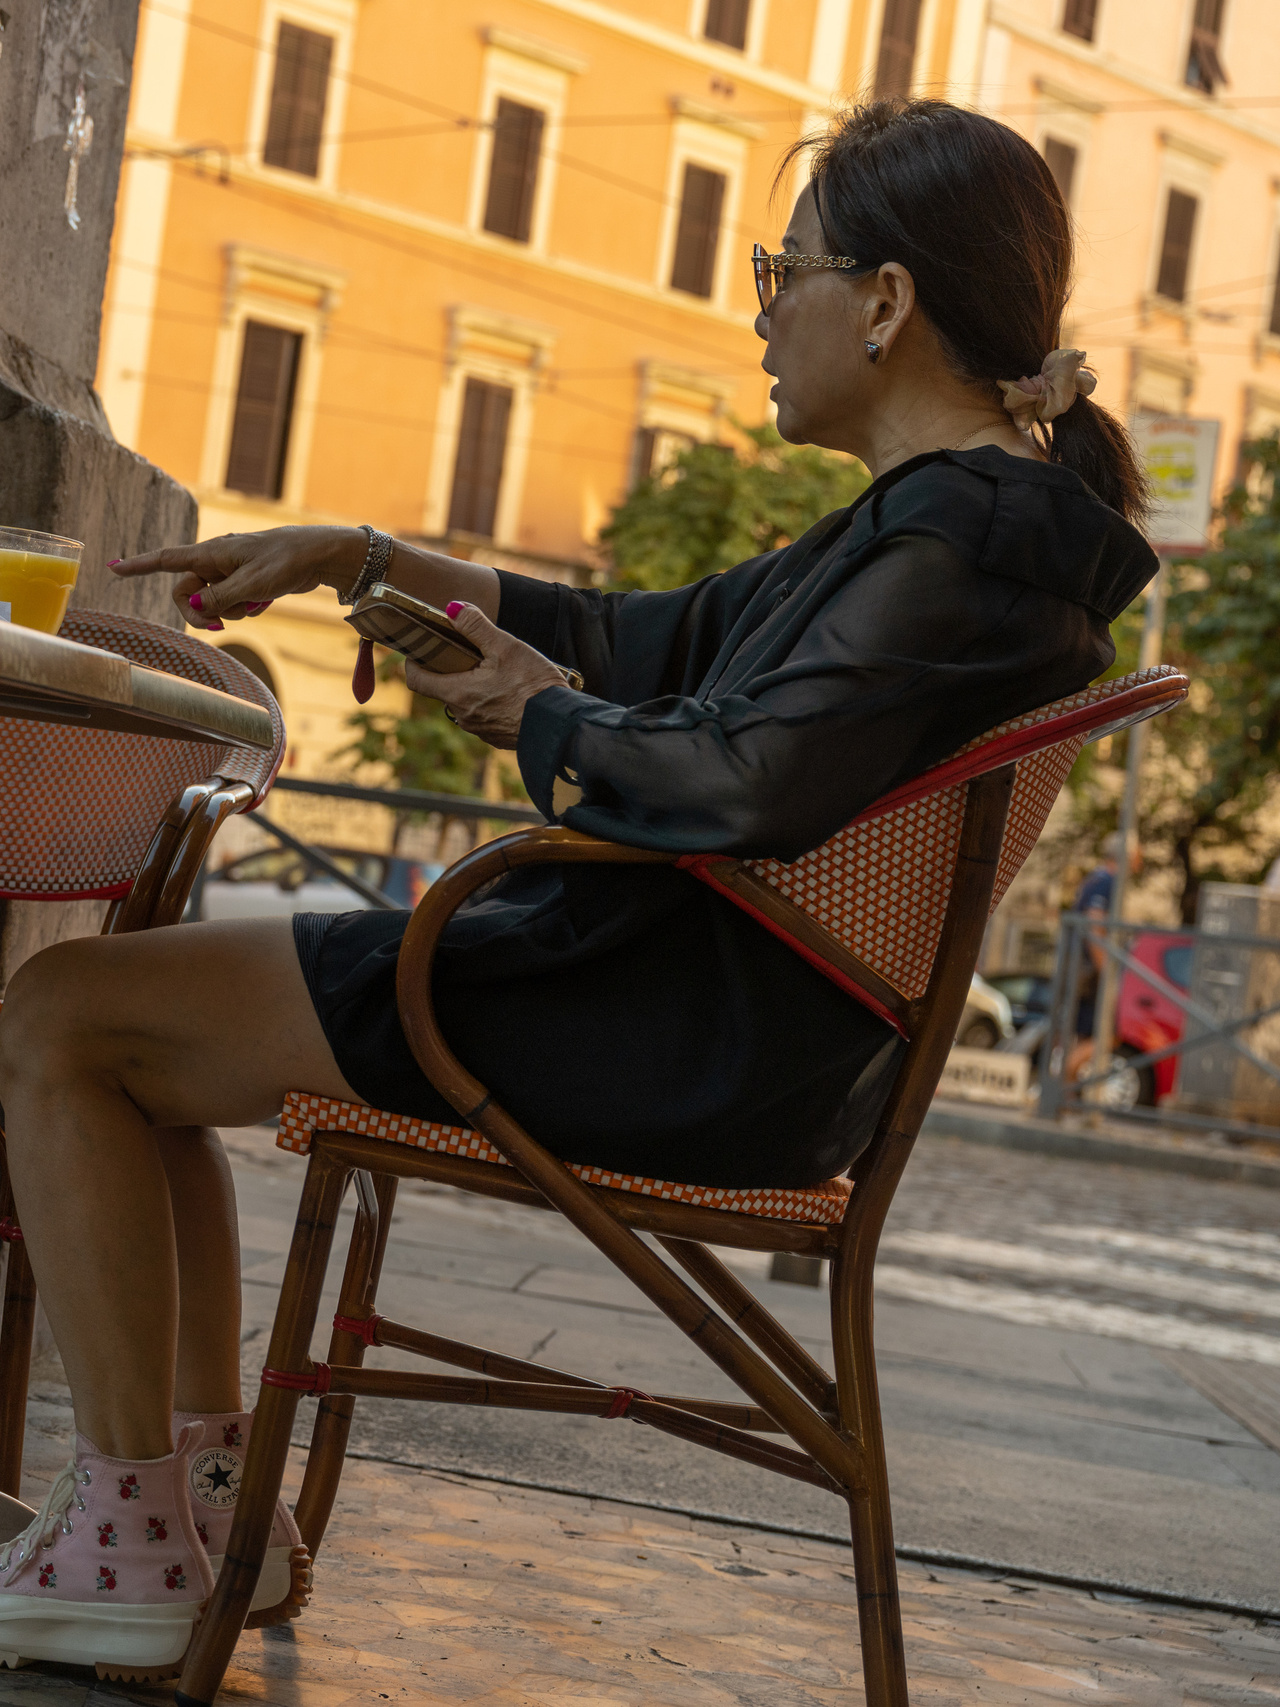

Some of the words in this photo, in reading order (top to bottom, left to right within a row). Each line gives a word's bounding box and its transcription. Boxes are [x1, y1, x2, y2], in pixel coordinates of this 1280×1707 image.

[195, 1453, 238, 1474] CONVERSE
[203, 1492, 218, 1503] ALL
[221, 1487, 240, 1503] STAR
